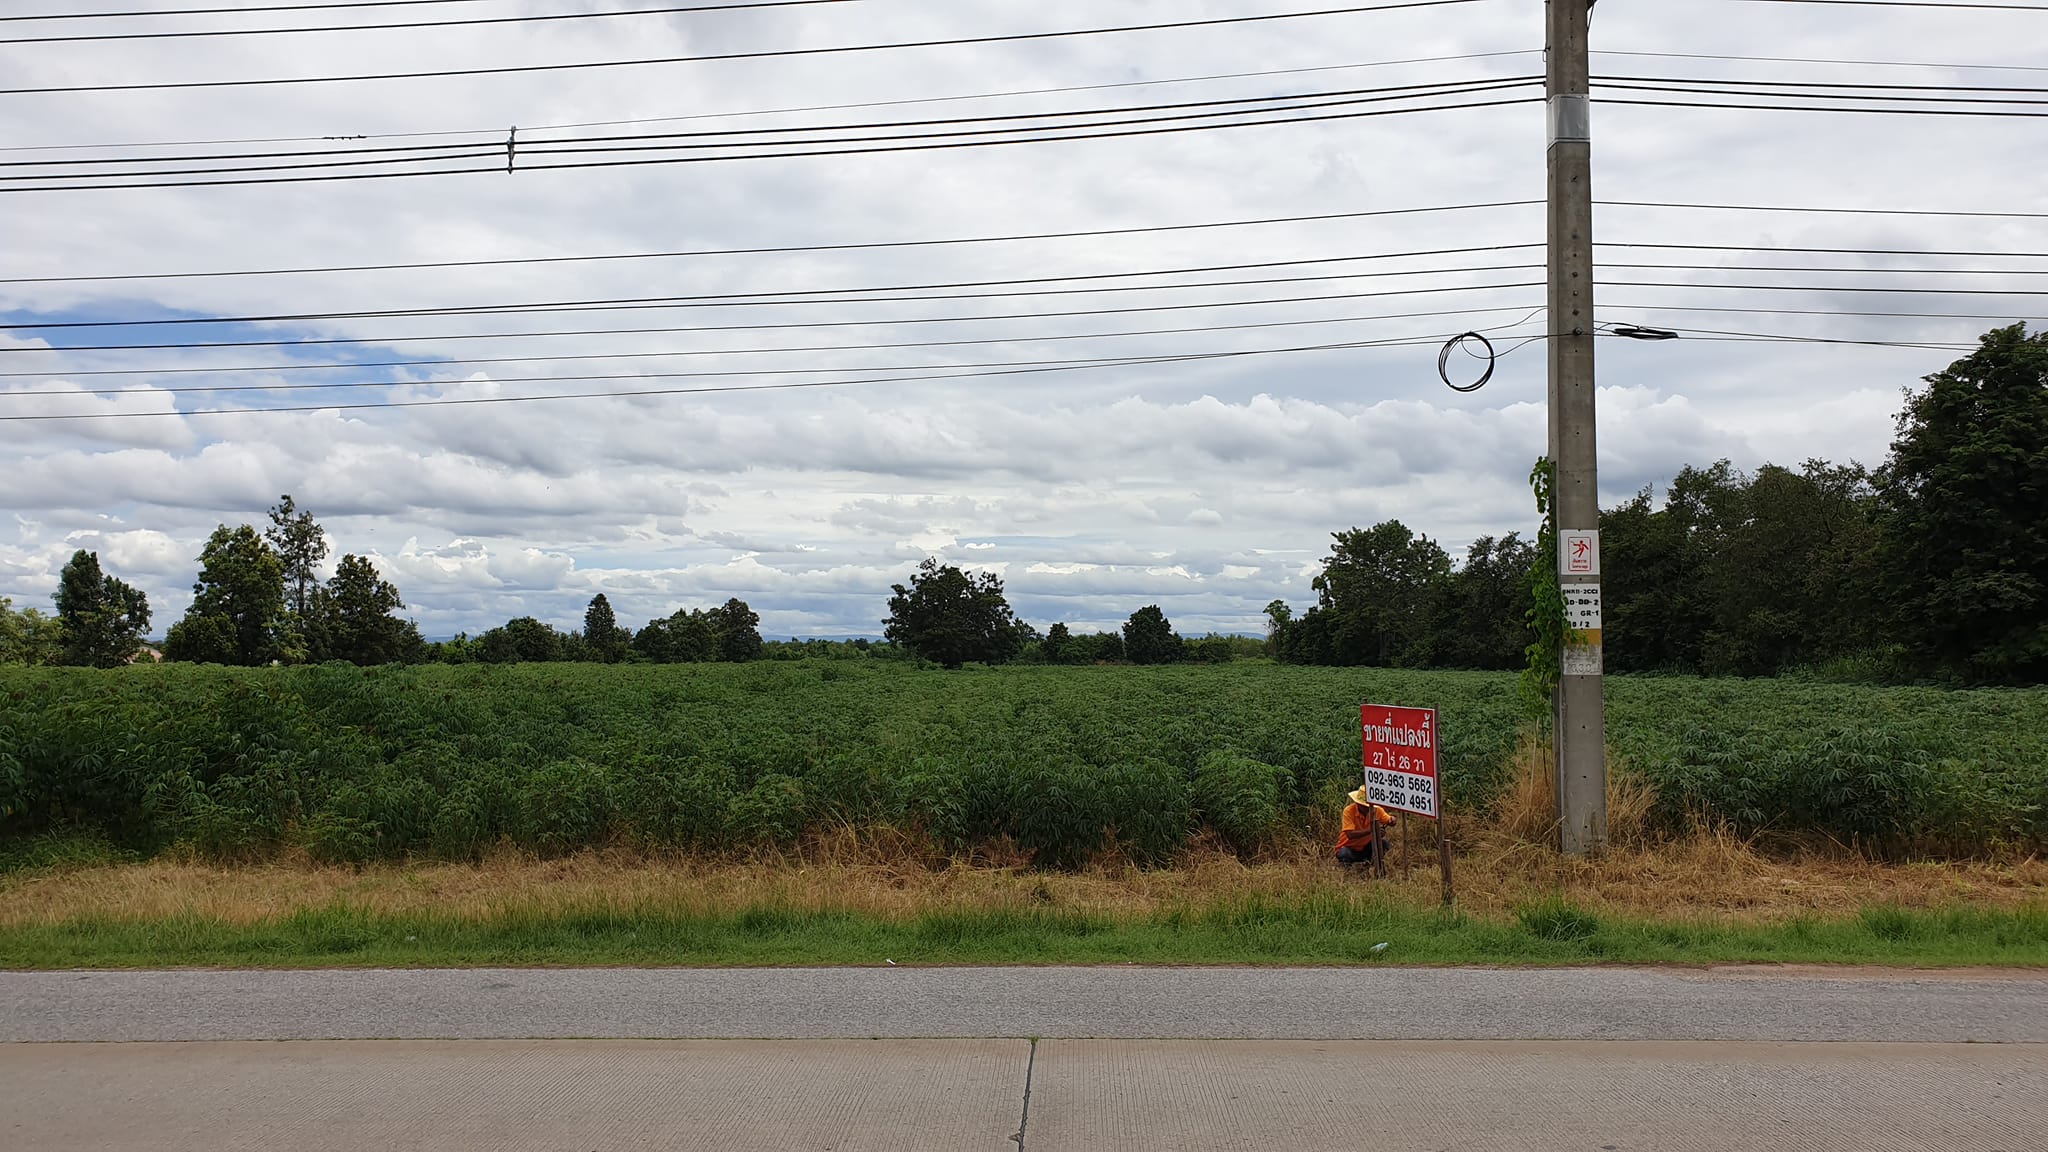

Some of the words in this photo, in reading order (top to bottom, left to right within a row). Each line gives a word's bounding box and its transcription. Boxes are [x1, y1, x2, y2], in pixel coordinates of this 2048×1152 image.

[1363, 712, 1431, 748] ขายที่แปลงนี้
[1373, 752, 1383, 765] 27
[1385, 747, 1396, 767] ไร่
[1398, 755, 1411, 770] 26
[1413, 759, 1425, 772] วา
[1368, 770, 1405, 788] 092-963
[1408, 777, 1432, 794] 5662
[1369, 787, 1406, 806] 086-250
[1409, 795, 1432, 811] 4951
